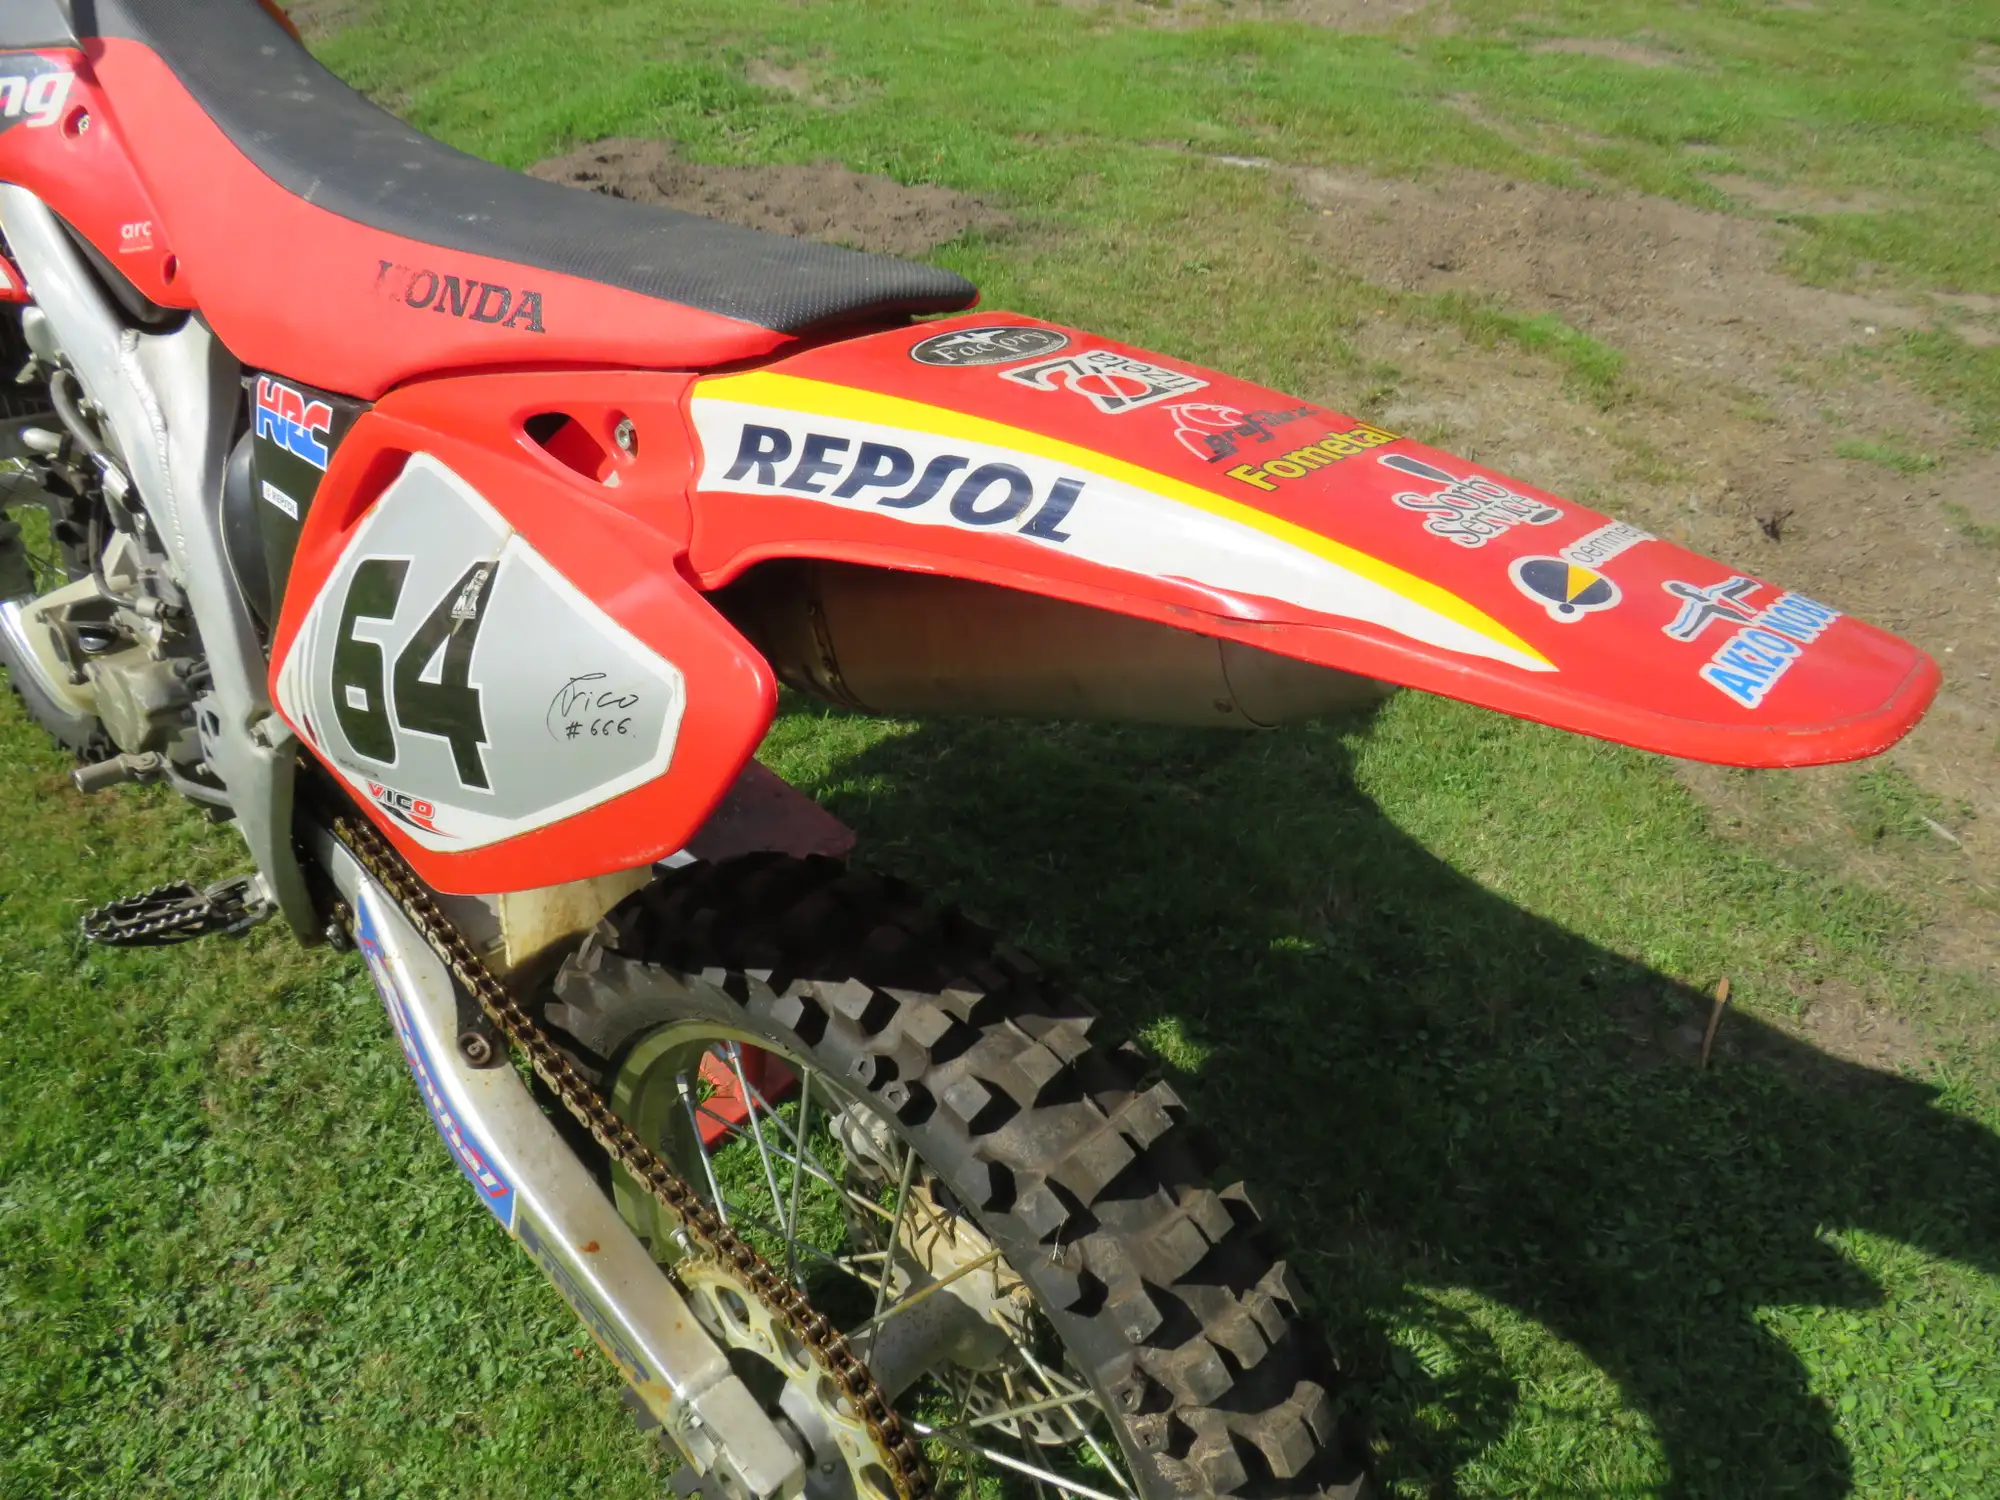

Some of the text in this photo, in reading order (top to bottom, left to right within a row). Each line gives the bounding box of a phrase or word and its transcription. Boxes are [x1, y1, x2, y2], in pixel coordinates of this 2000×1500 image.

[120, 221, 153, 239] arc
[256, 375, 334, 472] HRC
[1224, 421, 1403, 492] Fometal
[722, 423, 1086, 544] REPSOL
[330, 557, 501, 792] 64
[1708, 630, 1796, 702] AKZO
[366, 780, 436, 820] VICO
